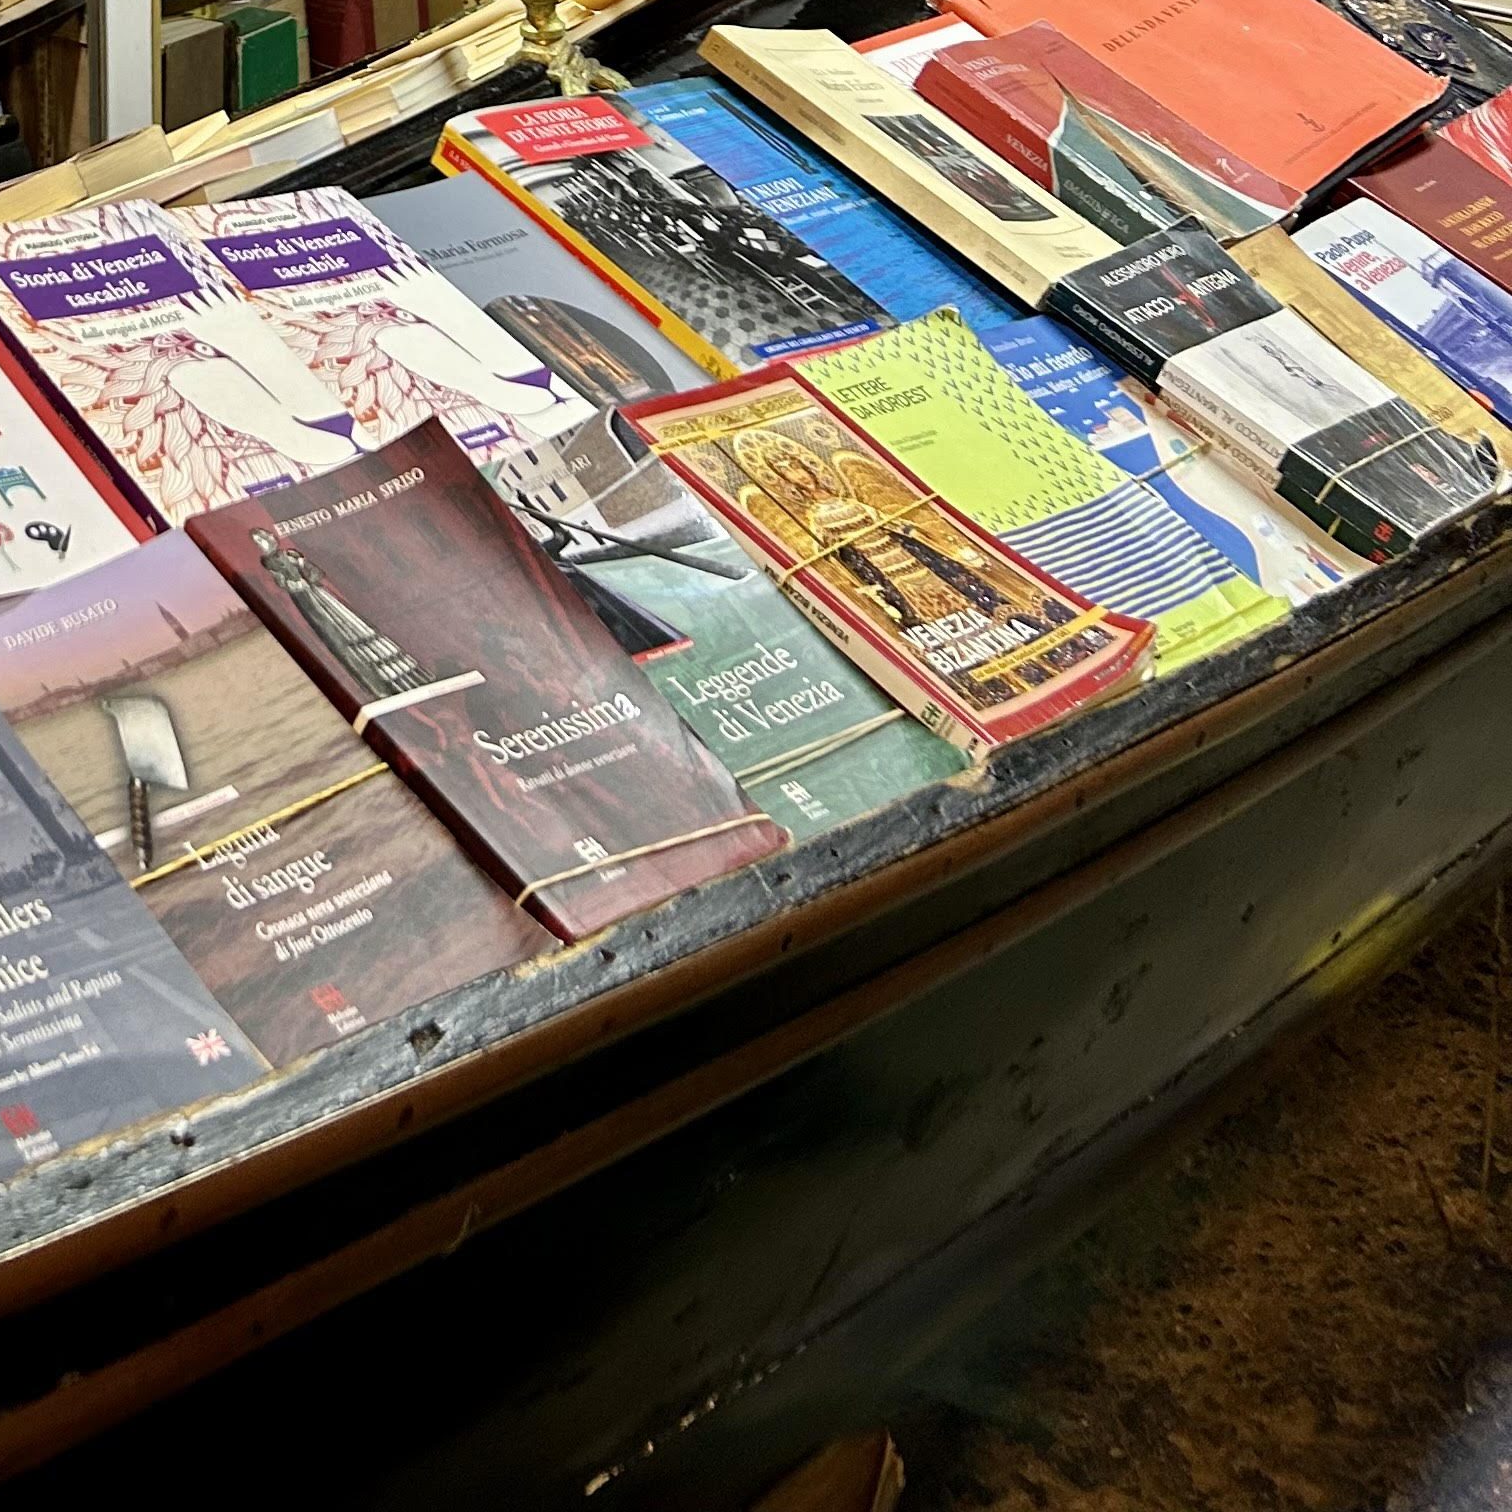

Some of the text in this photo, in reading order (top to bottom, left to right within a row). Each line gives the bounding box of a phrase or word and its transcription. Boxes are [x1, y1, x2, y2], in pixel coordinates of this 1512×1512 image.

[1102, 9, 1161, 53] DELENDA
[505, 115, 625, 144] DI TANTE STORIE
[513, 105, 588, 128] LA STORIA
[758, 177, 806, 197] NUOVI
[761, 187, 841, 215] VENEZIANI
[220, 228, 362, 264] Storia di Venezia
[424, 227, 529, 262] Maria Formosa
[1315, 242, 1349, 266] Paolo
[9, 248, 167, 288] Storia di Venezia
[274, 255, 351, 280] tascabile
[1361, 257, 1408, 287] Venezia
[64, 279, 150, 309] tascabile
[352, 281, 382, 296] MOSE
[149, 310, 185, 326] MOSE
[1123, 296, 1176, 325] ATTACCO
[830, 377, 892, 404] LETTERE
[848, 386, 933, 420] DA NORDEST
[275, 466, 427, 538] ERNESTO MARIA SFRISO
[4, 598, 118, 650] DAVIDE BUSATO
[898, 608, 993, 651] VENEZIA
[926, 618, 1040, 675] BIZANTINA
[668, 641, 800, 707] Leggende
[472, 691, 641, 766] Serenissima
[714, 680, 846, 743] di Venezia
[226, 846, 333, 910] di sangue
[256, 906, 305, 940] Cronaca
[306, 891, 341, 919] nera
[314, 907, 374, 947] Ottocento
[47, 984, 82, 1013] and
[0, 1012, 83, 1052] Serenissima
